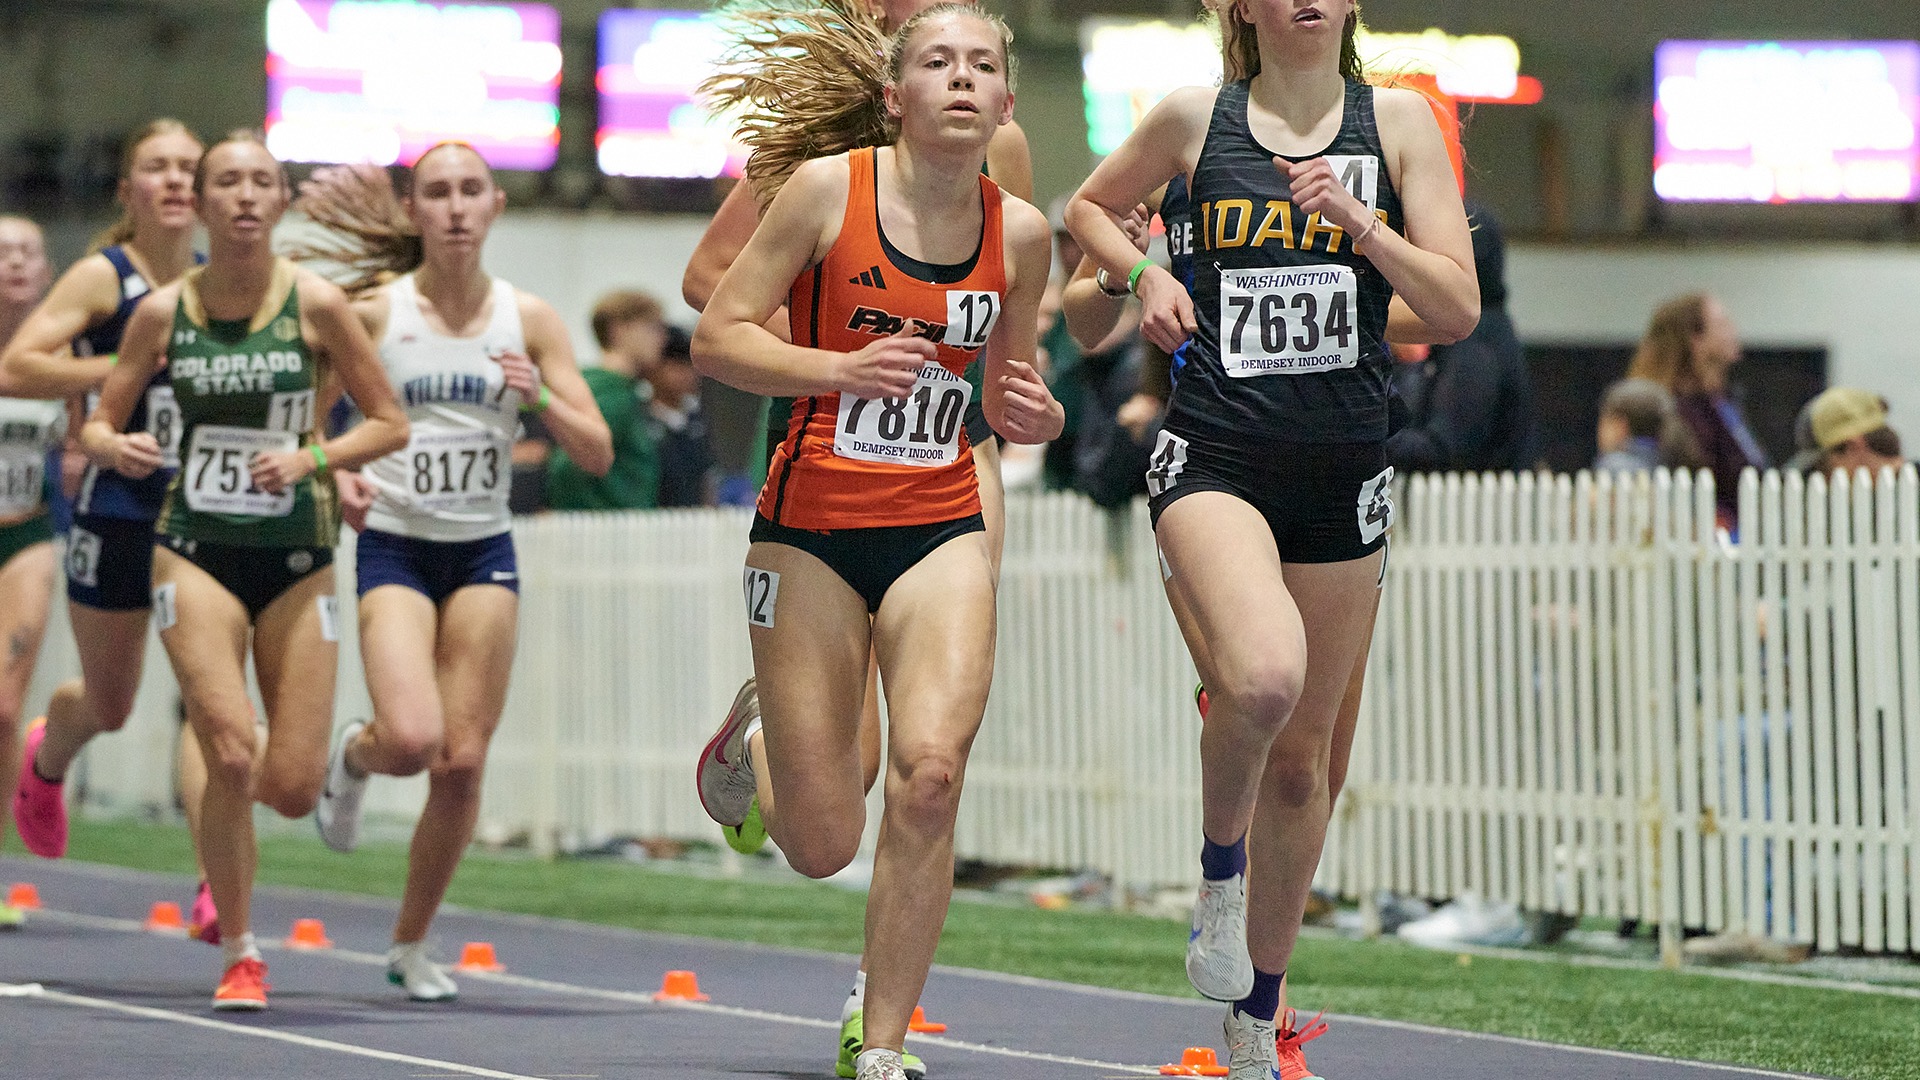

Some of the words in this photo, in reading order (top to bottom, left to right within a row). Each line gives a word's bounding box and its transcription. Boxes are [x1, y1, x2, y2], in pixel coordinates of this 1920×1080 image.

[1236, 271, 1341, 288] WASHINGTON
[959, 294, 993, 343] 12
[1228, 291, 1352, 355] 7634
[172, 351, 303, 379] COLORADO
[193, 373, 275, 396] STATE
[1241, 357, 1294, 370] DEMPSEY
[1298, 354, 1342, 367] INDOOR
[282, 396, 309, 431] 11
[194, 447, 287, 497] 75
[414, 446, 499, 495] 8173
[853, 441, 906, 458] DEMPSEY
[908, 447, 944, 460] INDOOR
[1148, 438, 1177, 492] 4
[1364, 476, 1391, 530] 4
[747, 570, 771, 623] 12
